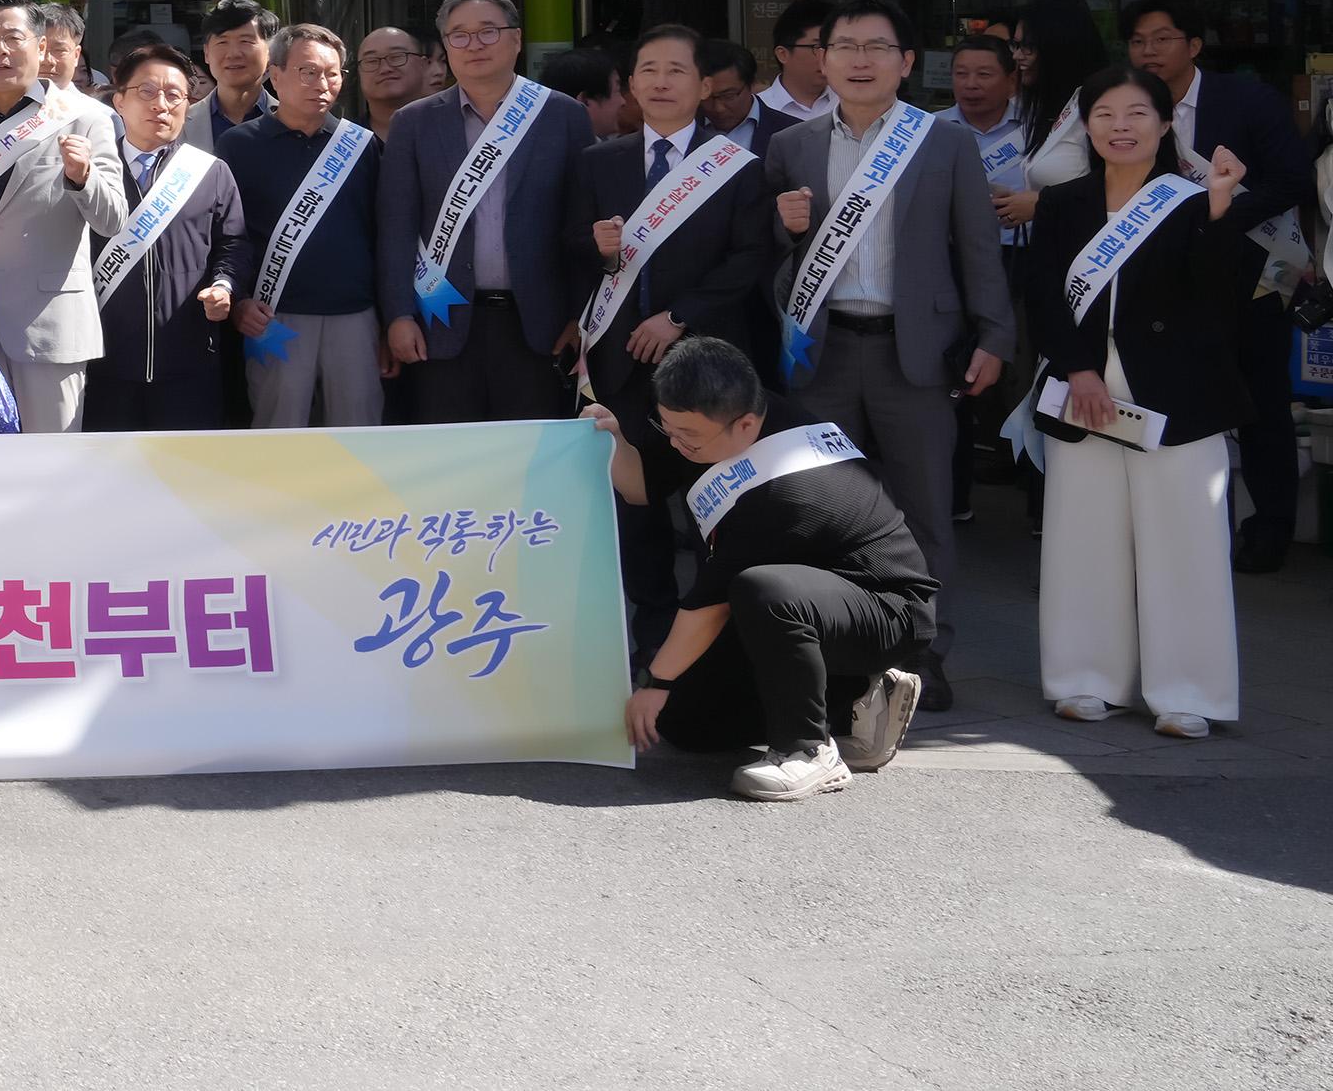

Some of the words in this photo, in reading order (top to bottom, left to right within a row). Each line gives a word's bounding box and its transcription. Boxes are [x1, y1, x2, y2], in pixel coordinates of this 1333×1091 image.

[450, 141, 503, 212] 장바구니는
[1127, 182, 1179, 228] 물가는
[276, 187, 324, 254] 장바구니는
[814, 191, 872, 270] 장바구니는
[312, 513, 412, 560] 시민과
[417, 510, 559, 572] 직통하는
[354, 570, 550, 678] 광주
